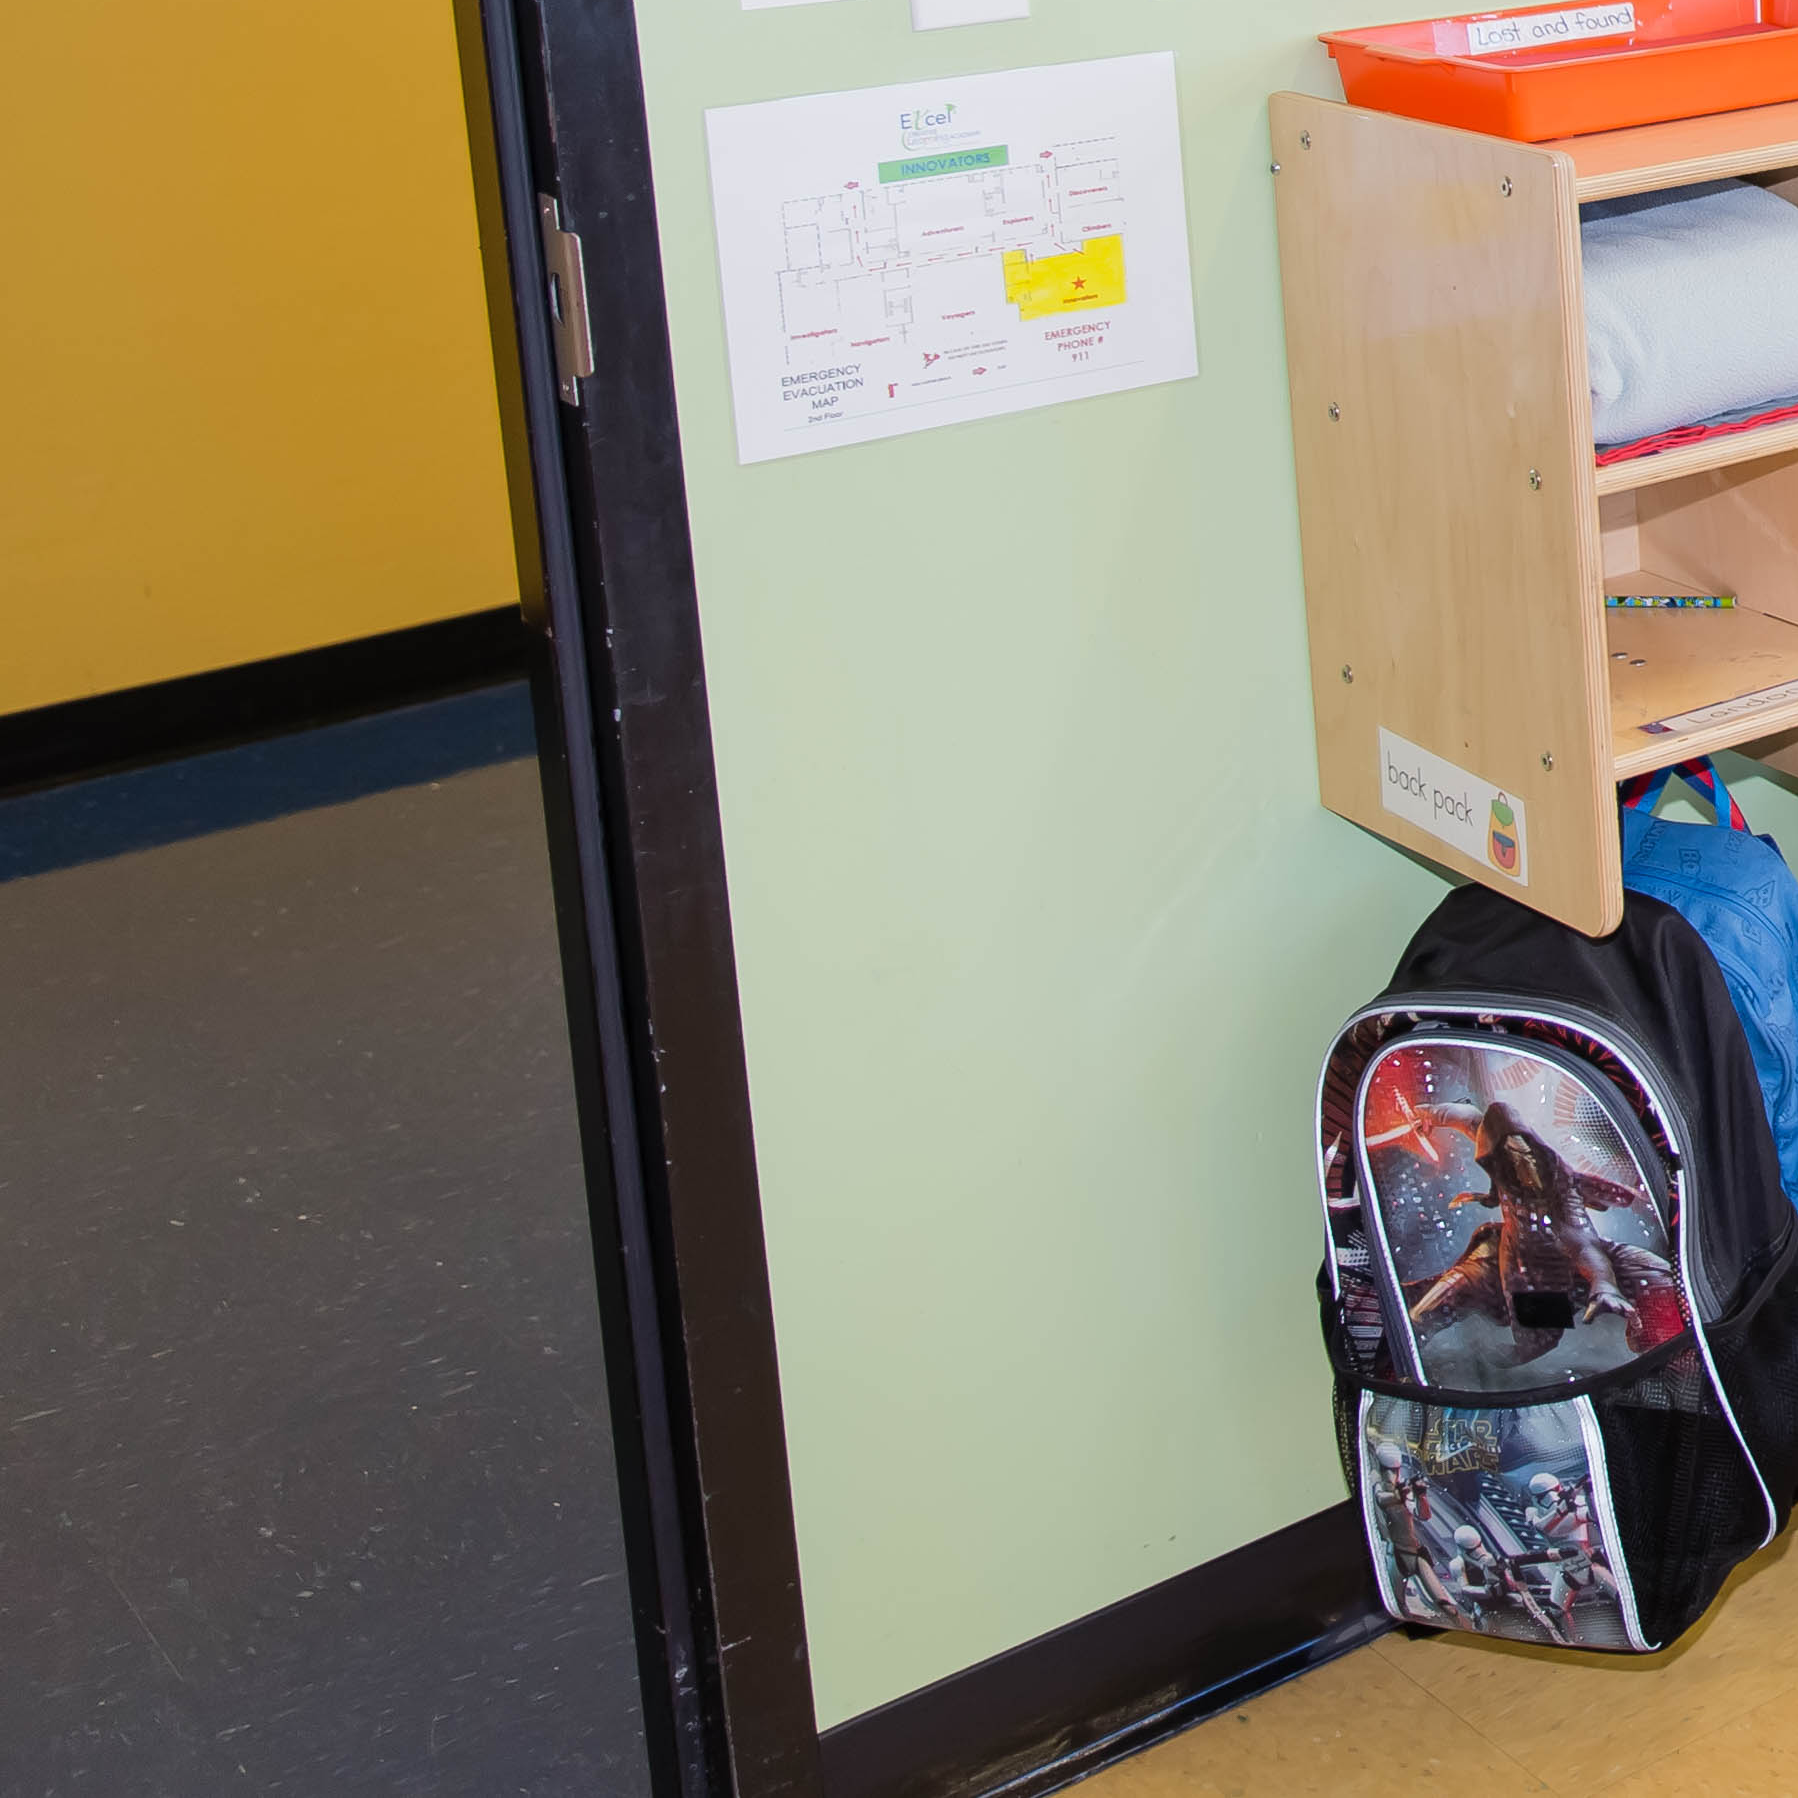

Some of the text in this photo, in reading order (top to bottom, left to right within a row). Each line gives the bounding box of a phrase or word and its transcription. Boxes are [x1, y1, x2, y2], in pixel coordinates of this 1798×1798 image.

[1477, 6, 1633, 46] Lost and found
[901, 152, 991, 175] INNOVATORS
[1044, 320, 1111, 341] EMERGENCY
[1057, 335, 1104, 352] PHONE #
[1071, 351, 1090, 362] 911
[781, 363, 862, 387] EMERGENCY
[782, 377, 864, 401] EVACUATION
[811, 395, 839, 410] MAP
[807, 411, 844, 424] 2nd Floor
[1387, 750, 1474, 827] back pack
